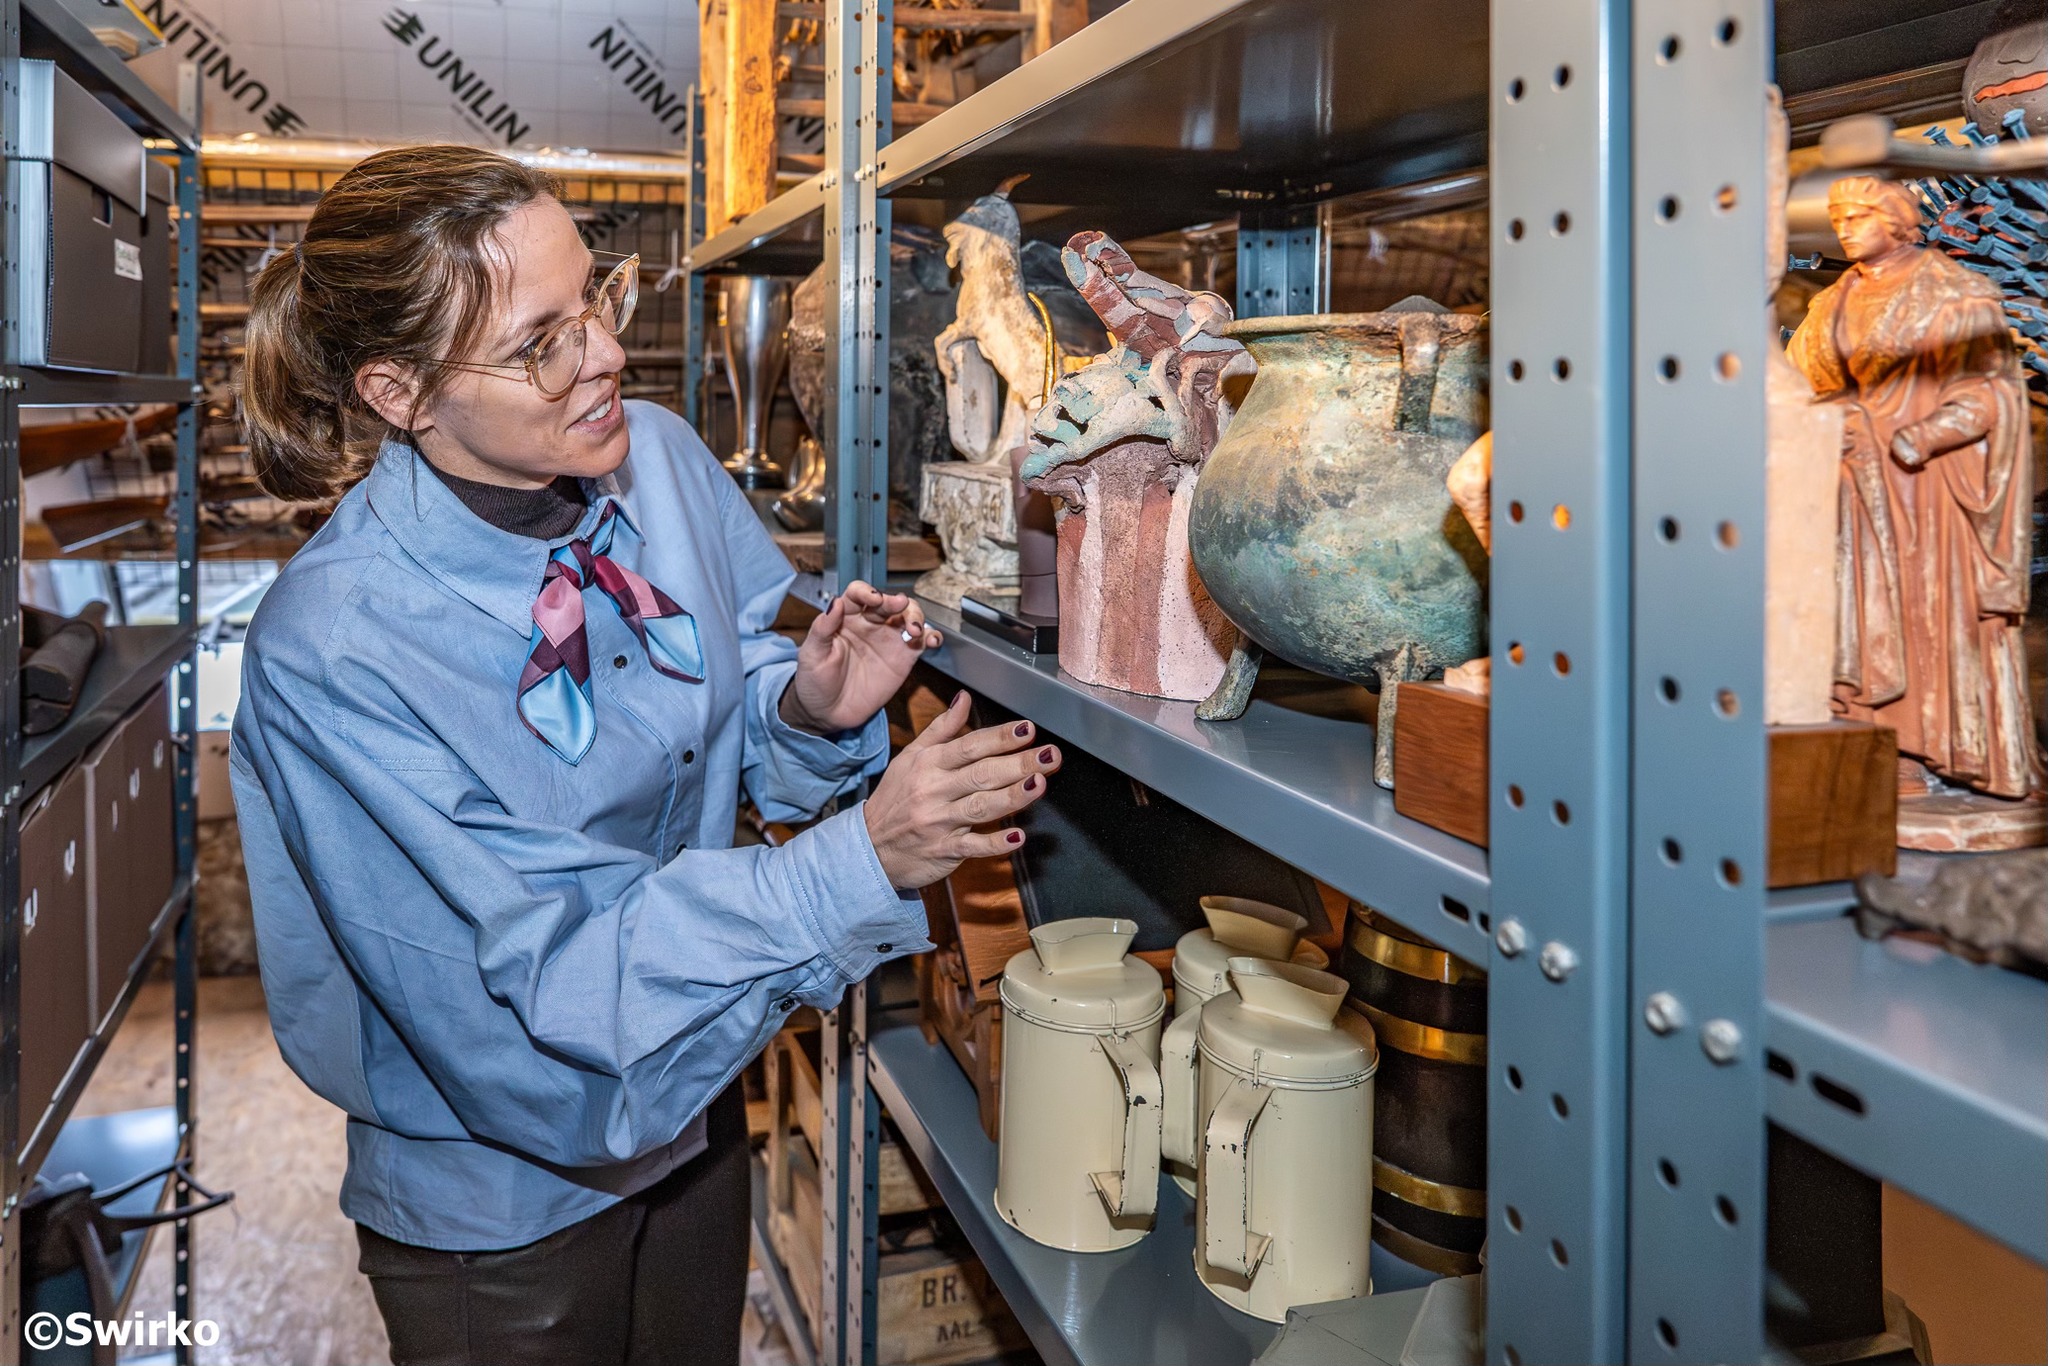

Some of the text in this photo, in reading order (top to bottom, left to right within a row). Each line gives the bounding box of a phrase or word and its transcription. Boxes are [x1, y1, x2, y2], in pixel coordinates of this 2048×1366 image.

[143, 0, 270, 113] UNILIN
[417, 35, 531, 146] UNILIN
[588, 24, 686, 135] UNILIN
